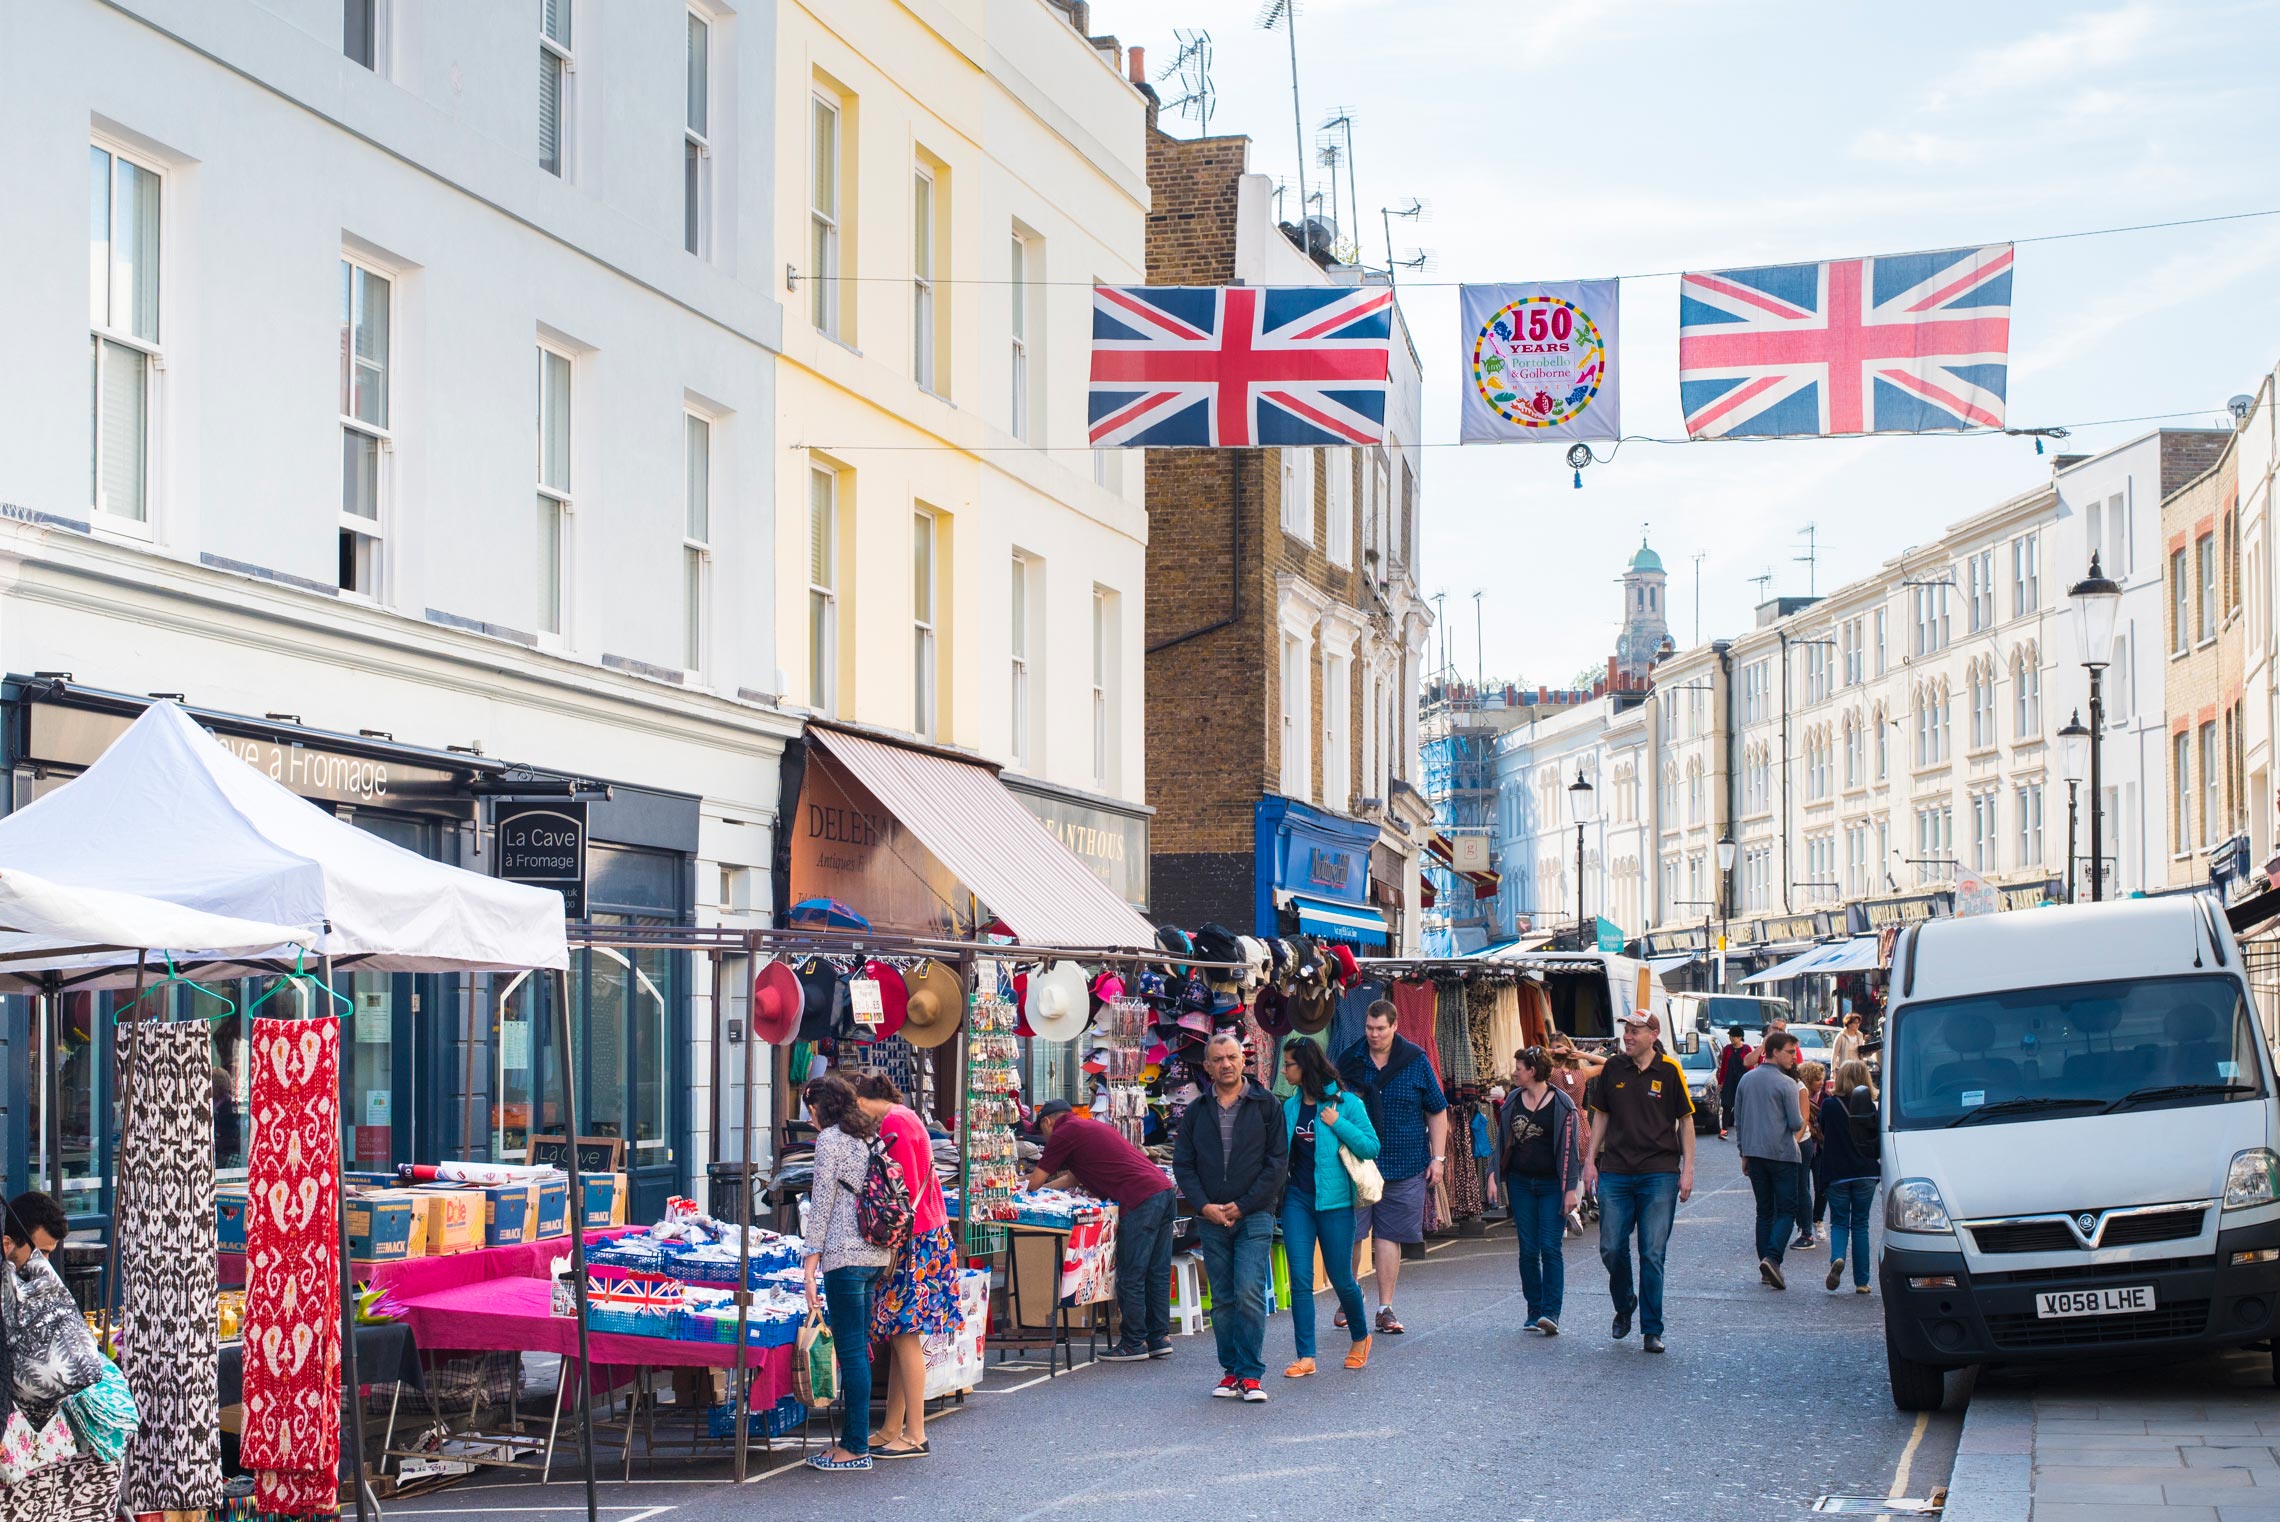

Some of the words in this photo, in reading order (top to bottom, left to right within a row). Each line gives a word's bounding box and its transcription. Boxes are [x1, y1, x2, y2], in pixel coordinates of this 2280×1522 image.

[1510, 307, 1573, 341] 150
[1510, 343, 1570, 353] YEARS
[1512, 355, 1571, 368] Portobello
[290, 742, 387, 801] Fromage
[506, 828, 526, 847] La
[531, 828, 575, 847] Cave
[505, 853, 513, 867] à
[516, 854, 574, 869] Fromage
[816, 852, 855, 874] Antiques
[540, 1145, 558, 1161] La
[561, 1146, 600, 1165] Cve
[385, 1241, 406, 1254] MACK
[2104, 1288, 2146, 1310] LHE
